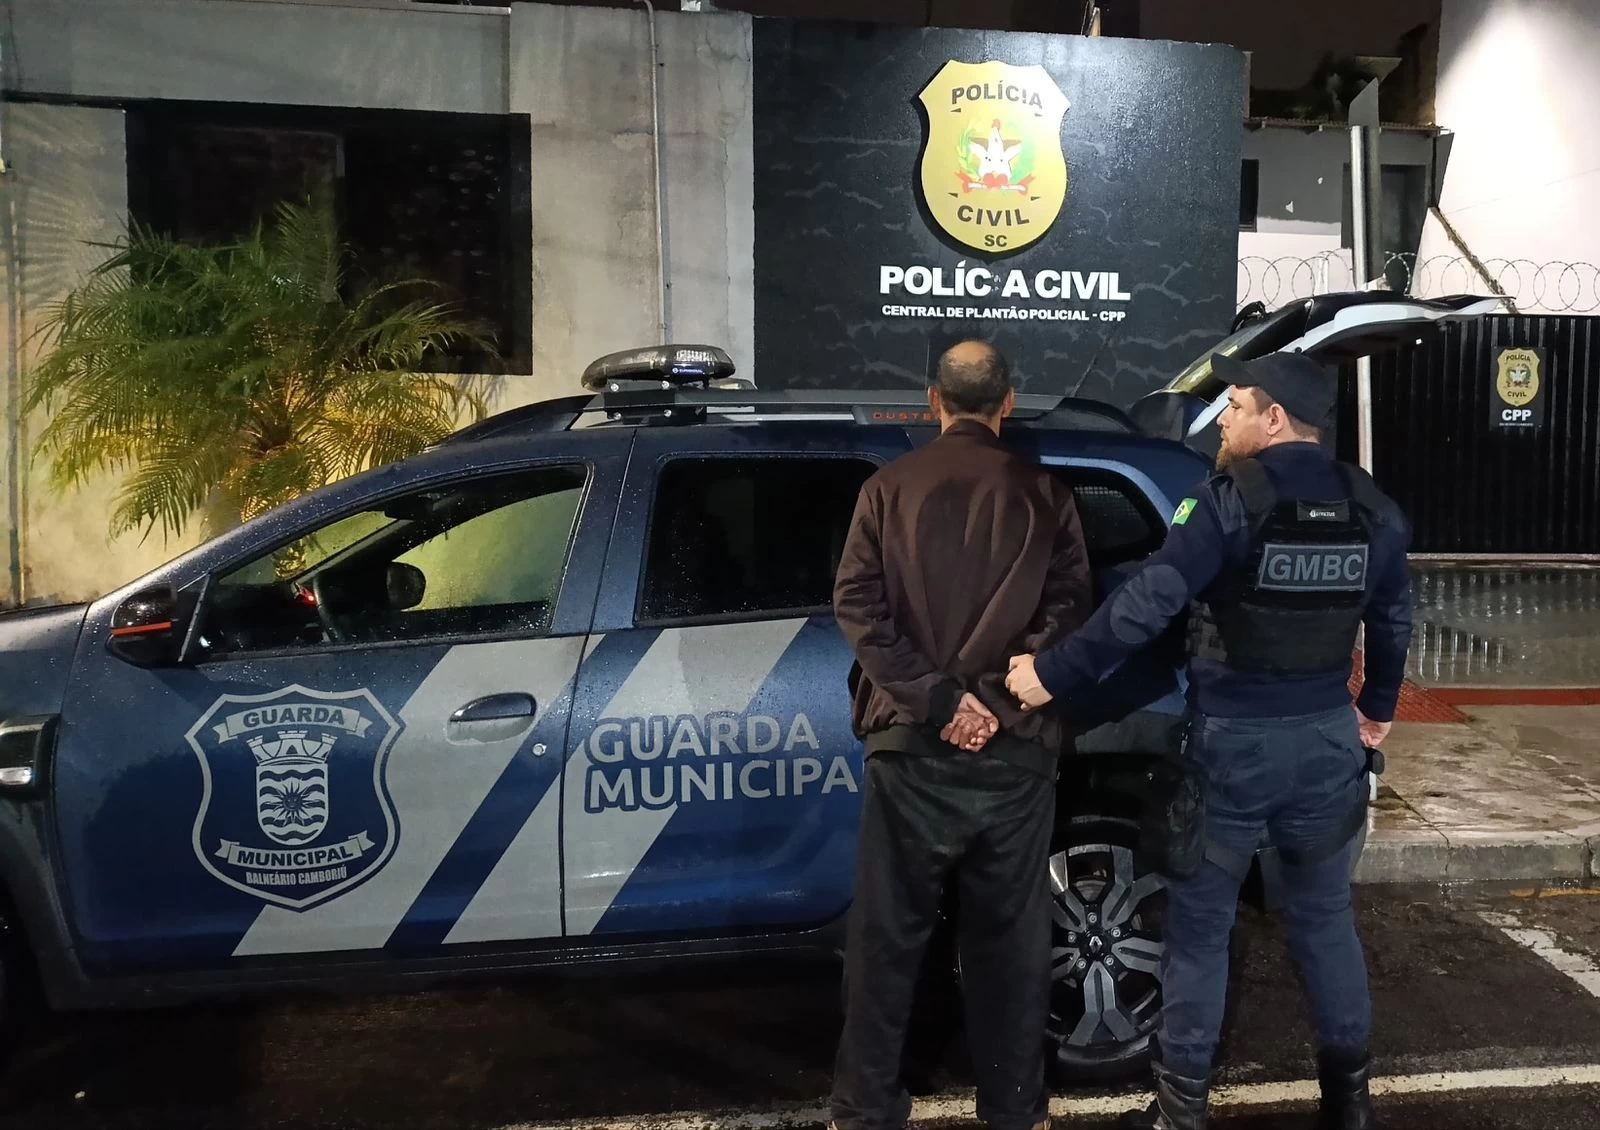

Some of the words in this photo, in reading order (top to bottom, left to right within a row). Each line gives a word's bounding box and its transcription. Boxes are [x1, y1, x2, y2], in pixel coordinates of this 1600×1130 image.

[951, 80, 1043, 109] POLÍCIA
[957, 205, 1030, 227] CIVIL
[984, 234, 1008, 247] SC
[1034, 270, 1131, 301] CIVIL
[882, 305, 944, 317] CENTRAL
[946, 307, 963, 318] DE
[966, 306, 1028, 321] PLANTÃO
[1029, 310, 1089, 322] POLICIAL
[1099, 311, 1126, 322] CPP
[1502, 409, 1532, 421] CPP
[1268, 553, 1363, 581] GMBC
[243, 707, 345, 728] GUARDA
[588, 713, 820, 763] GUARDA
[588, 756, 864, 809] MUNICIPA
[237, 846, 354, 866] MUNICIPAL
[246, 871, 297, 886] BALNEÁRIO
[298, 864, 347, 885] CAMBORIÚ
